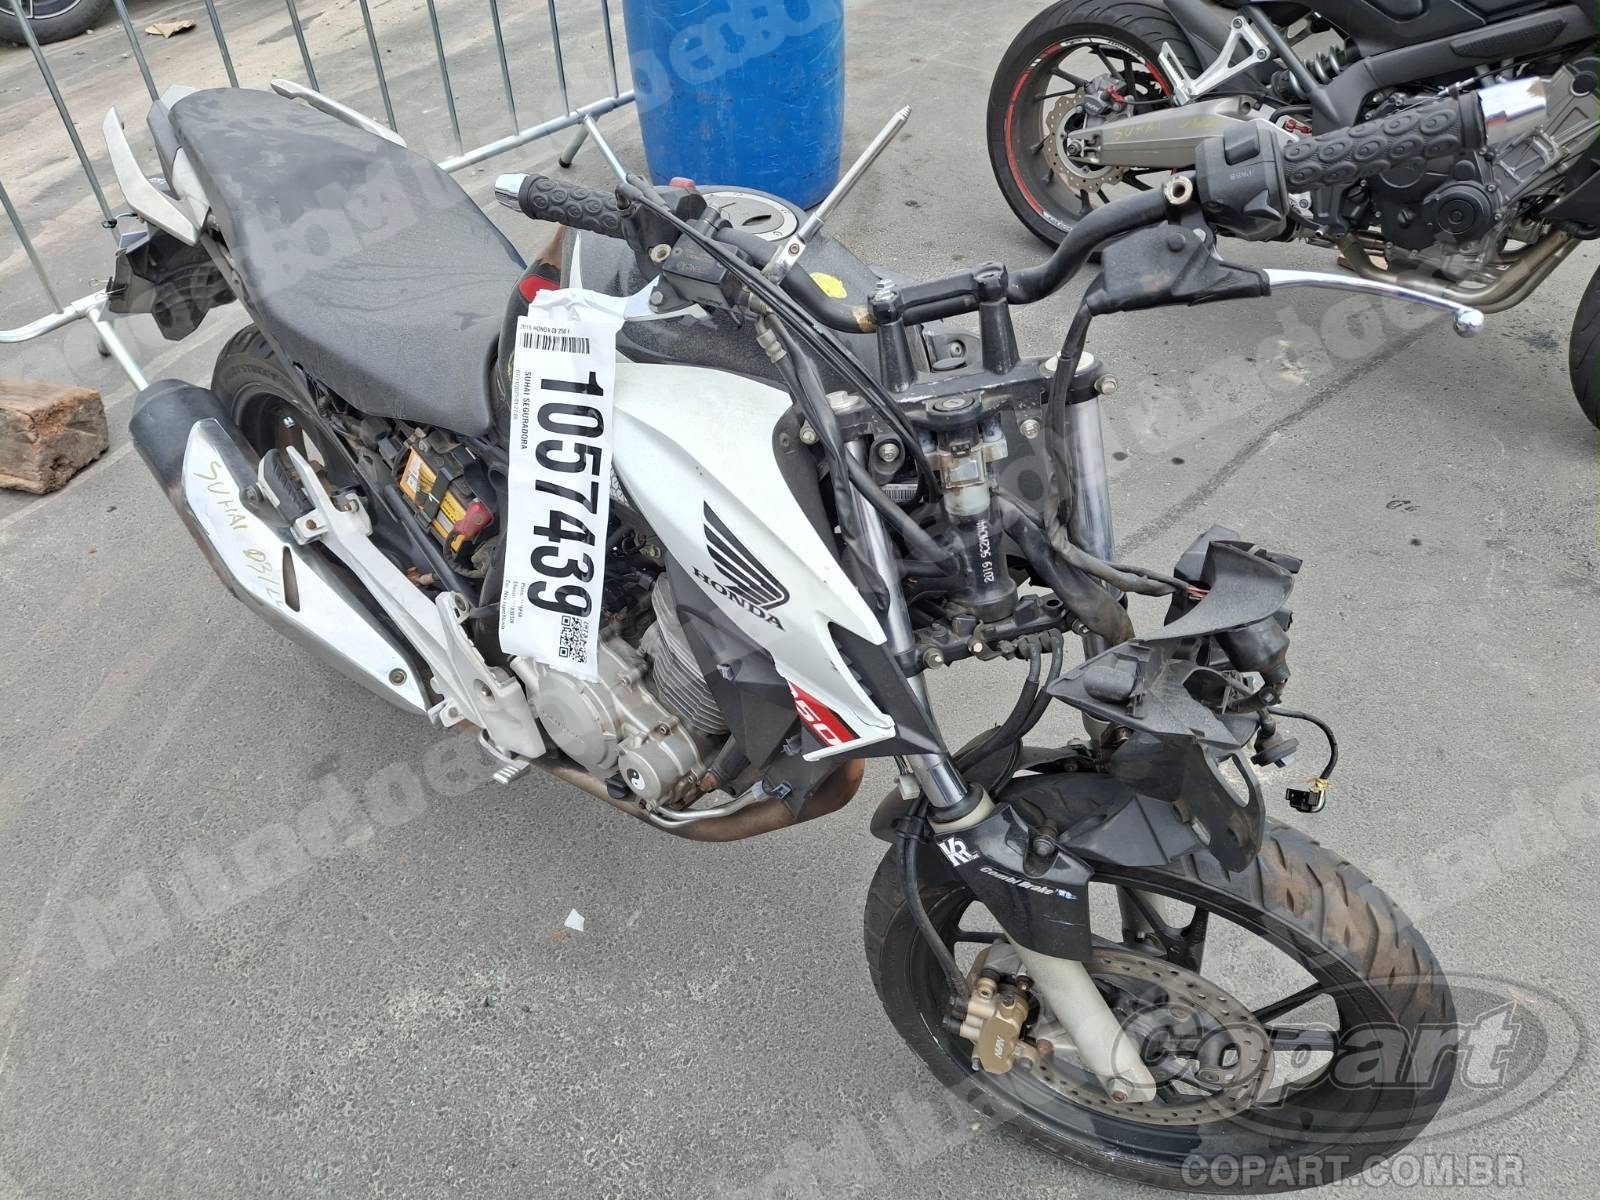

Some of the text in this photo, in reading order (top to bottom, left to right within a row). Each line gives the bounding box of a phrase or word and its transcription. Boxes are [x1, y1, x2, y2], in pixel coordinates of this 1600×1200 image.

[519, 371, 532, 450] SUHAI SEGURADORA
[193, 460, 248, 530] SUHAI
[527, 371, 604, 617] 1057439
[691, 566, 787, 632] HONDA
[981, 561, 995, 584] 2019
[790, 688, 842, 745] 50
[979, 866, 1019, 885] Combi
[1016, 880, 1054, 896] Brake
